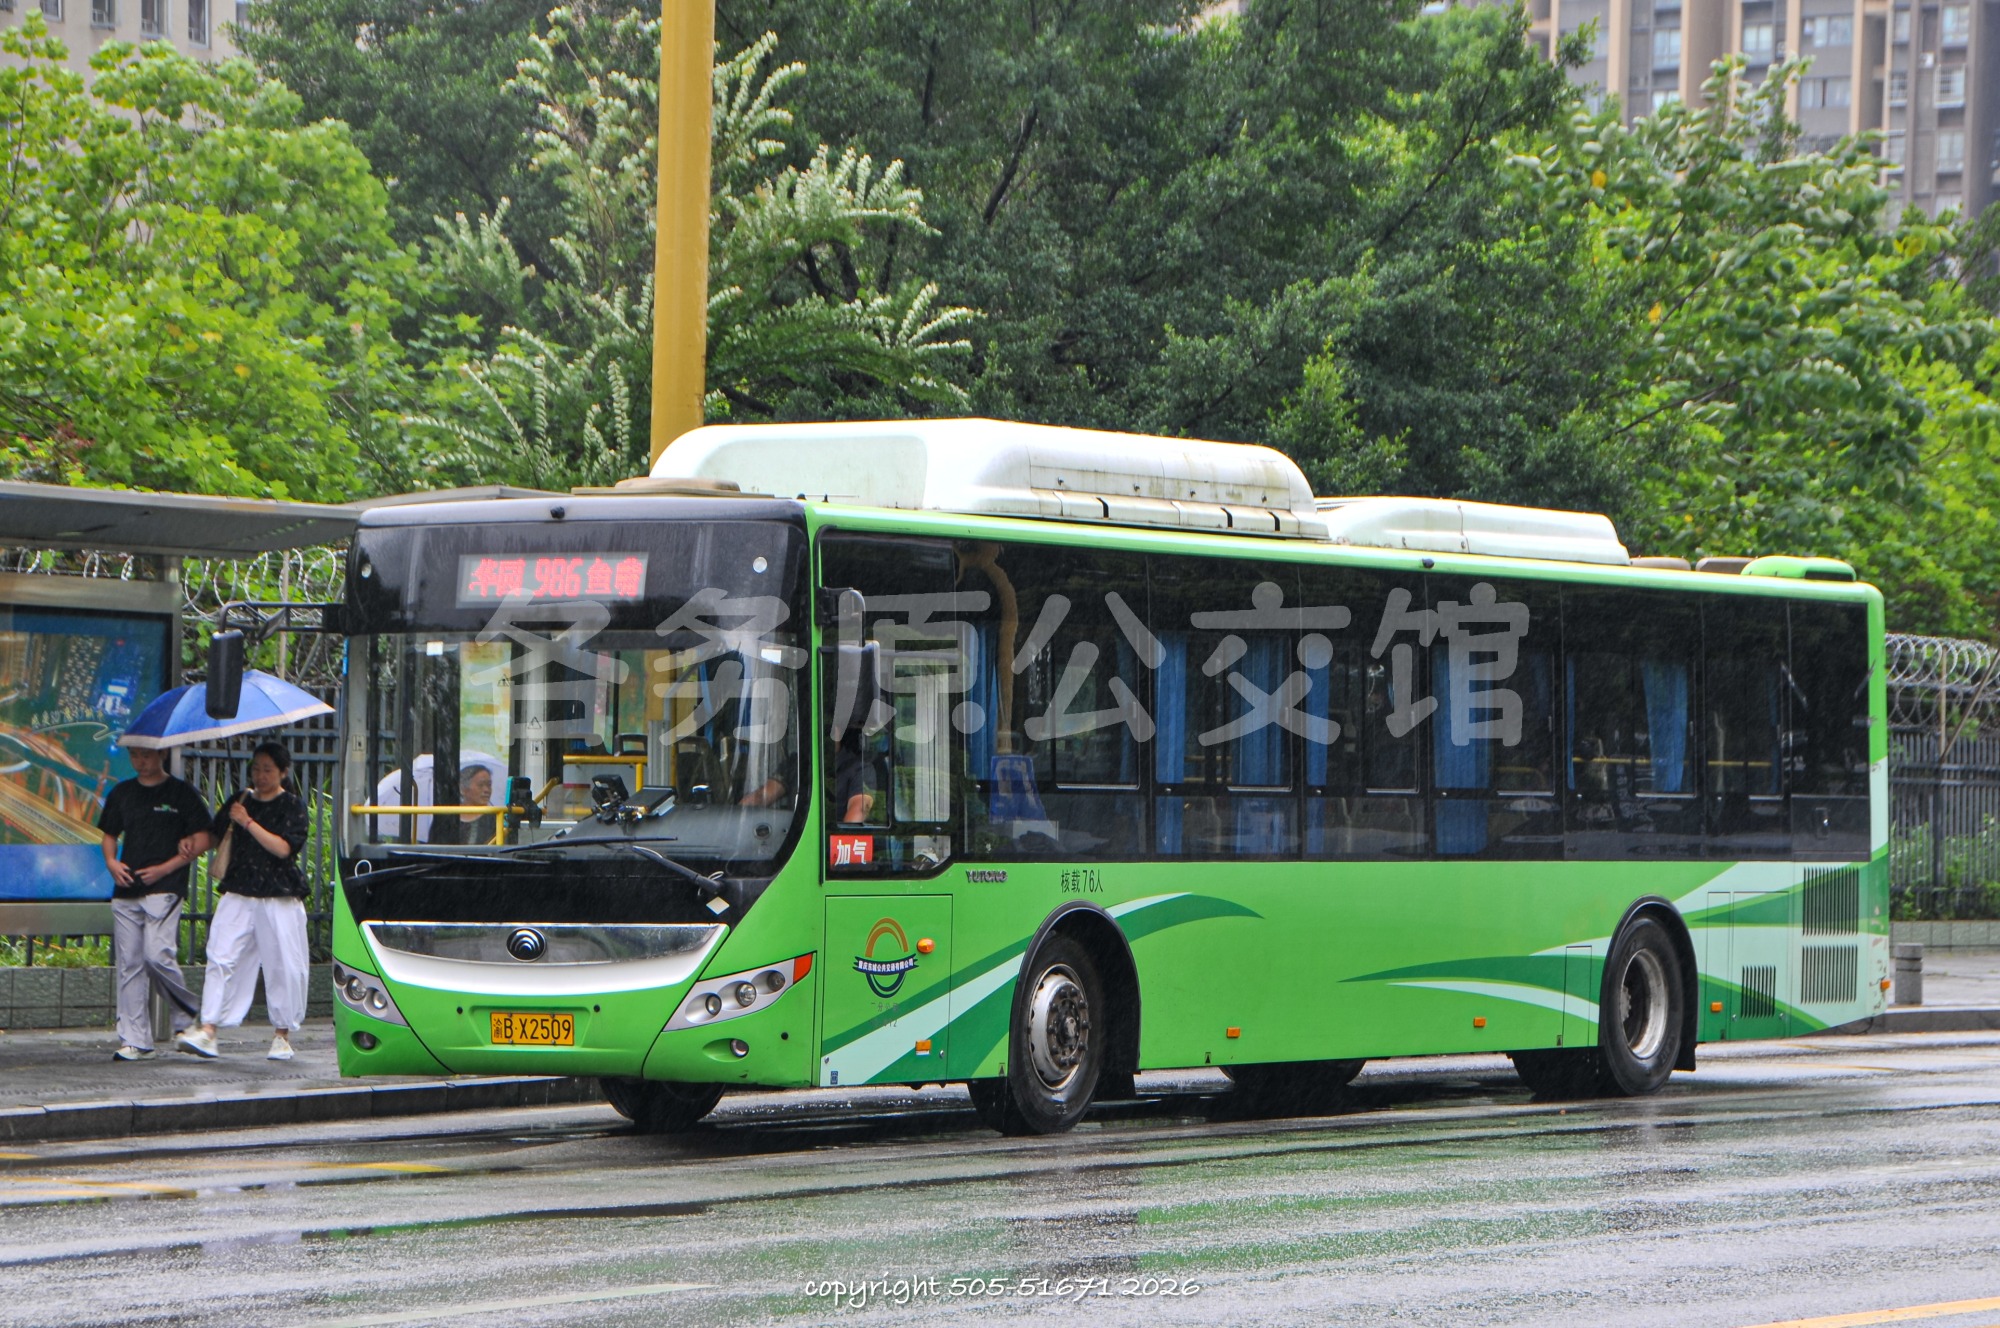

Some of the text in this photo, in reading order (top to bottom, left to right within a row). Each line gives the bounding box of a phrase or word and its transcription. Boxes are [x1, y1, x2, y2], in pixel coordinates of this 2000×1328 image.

[534, 557, 583, 597] 986
[834, 838, 868, 867] 加气
[965, 870, 1008, 883] YUTONG
